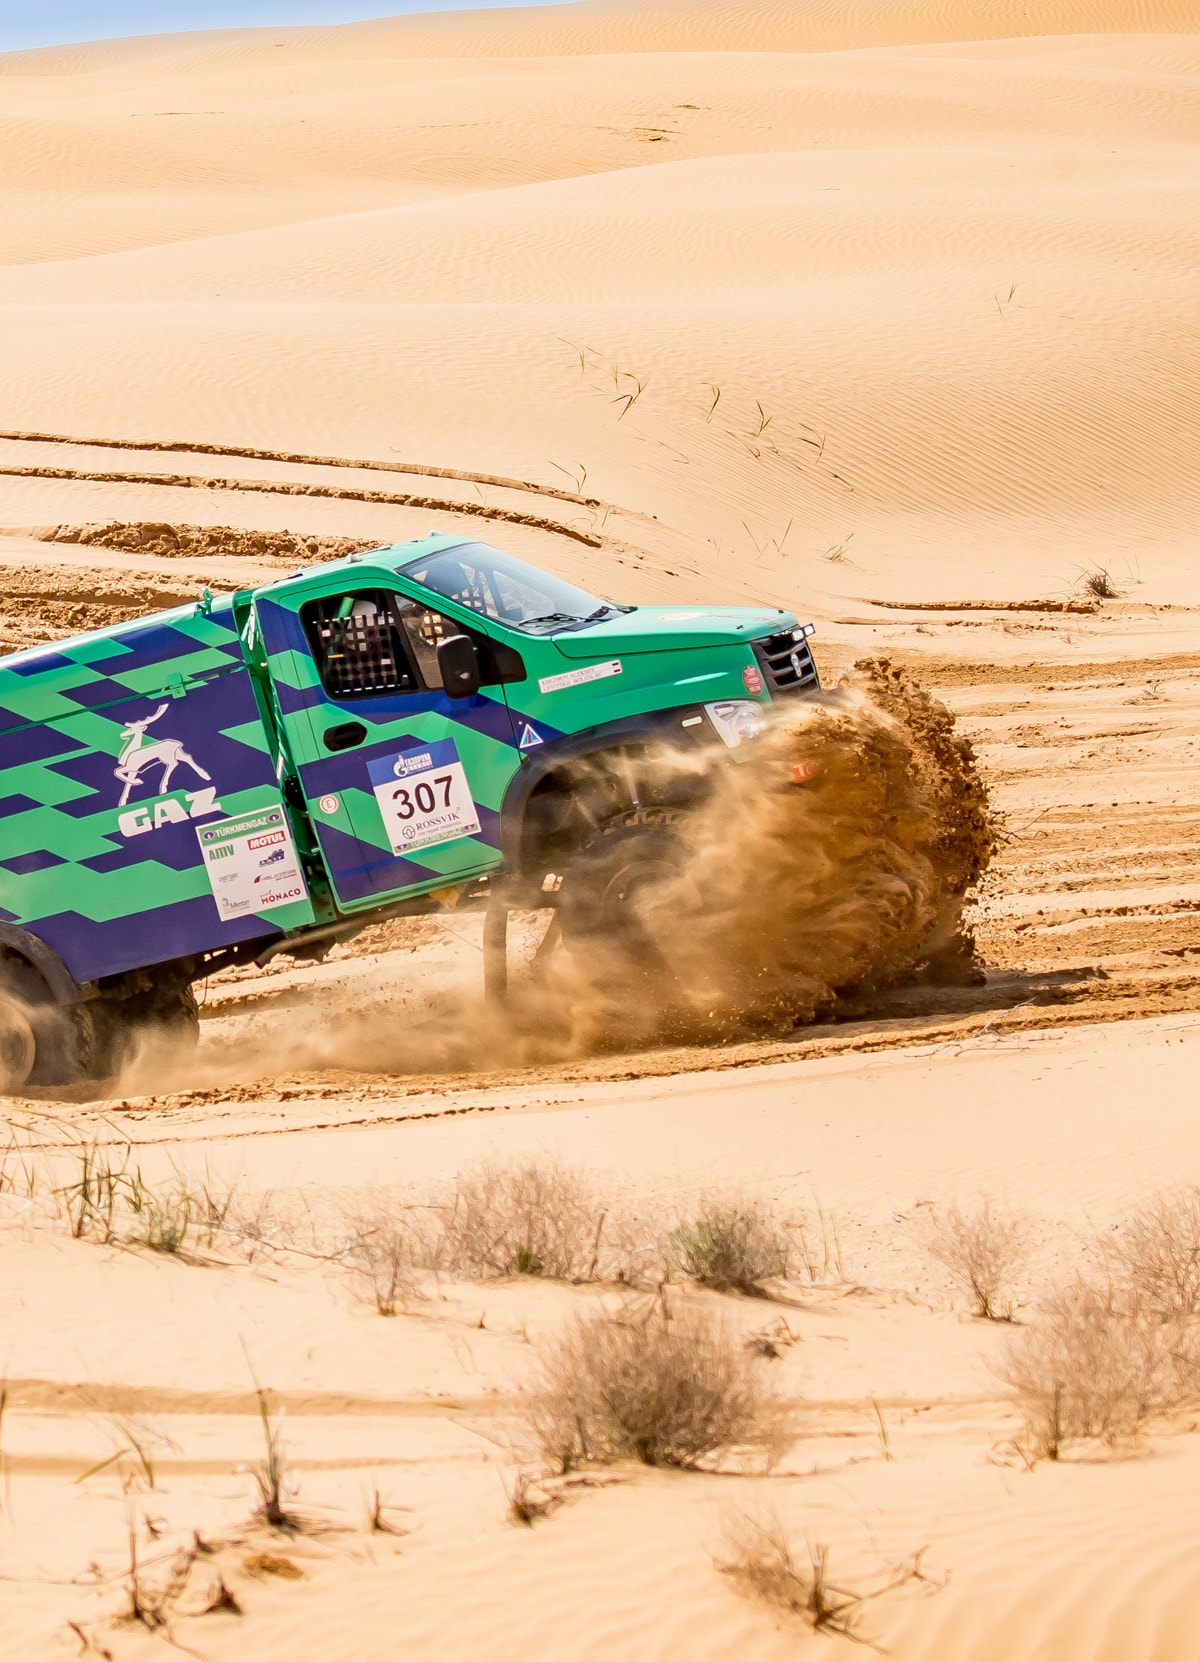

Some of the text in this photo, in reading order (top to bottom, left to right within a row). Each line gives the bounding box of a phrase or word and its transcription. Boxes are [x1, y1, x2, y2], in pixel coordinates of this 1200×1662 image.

[392, 775, 453, 820] 307
[118, 786, 222, 838] GAZ
[415, 812, 460, 830] ROSSVIK
[214, 816, 268, 838] TÜRKMENGAZ
[250, 834, 285, 849] MOTUL
[261, 888, 301, 905] MONACO
